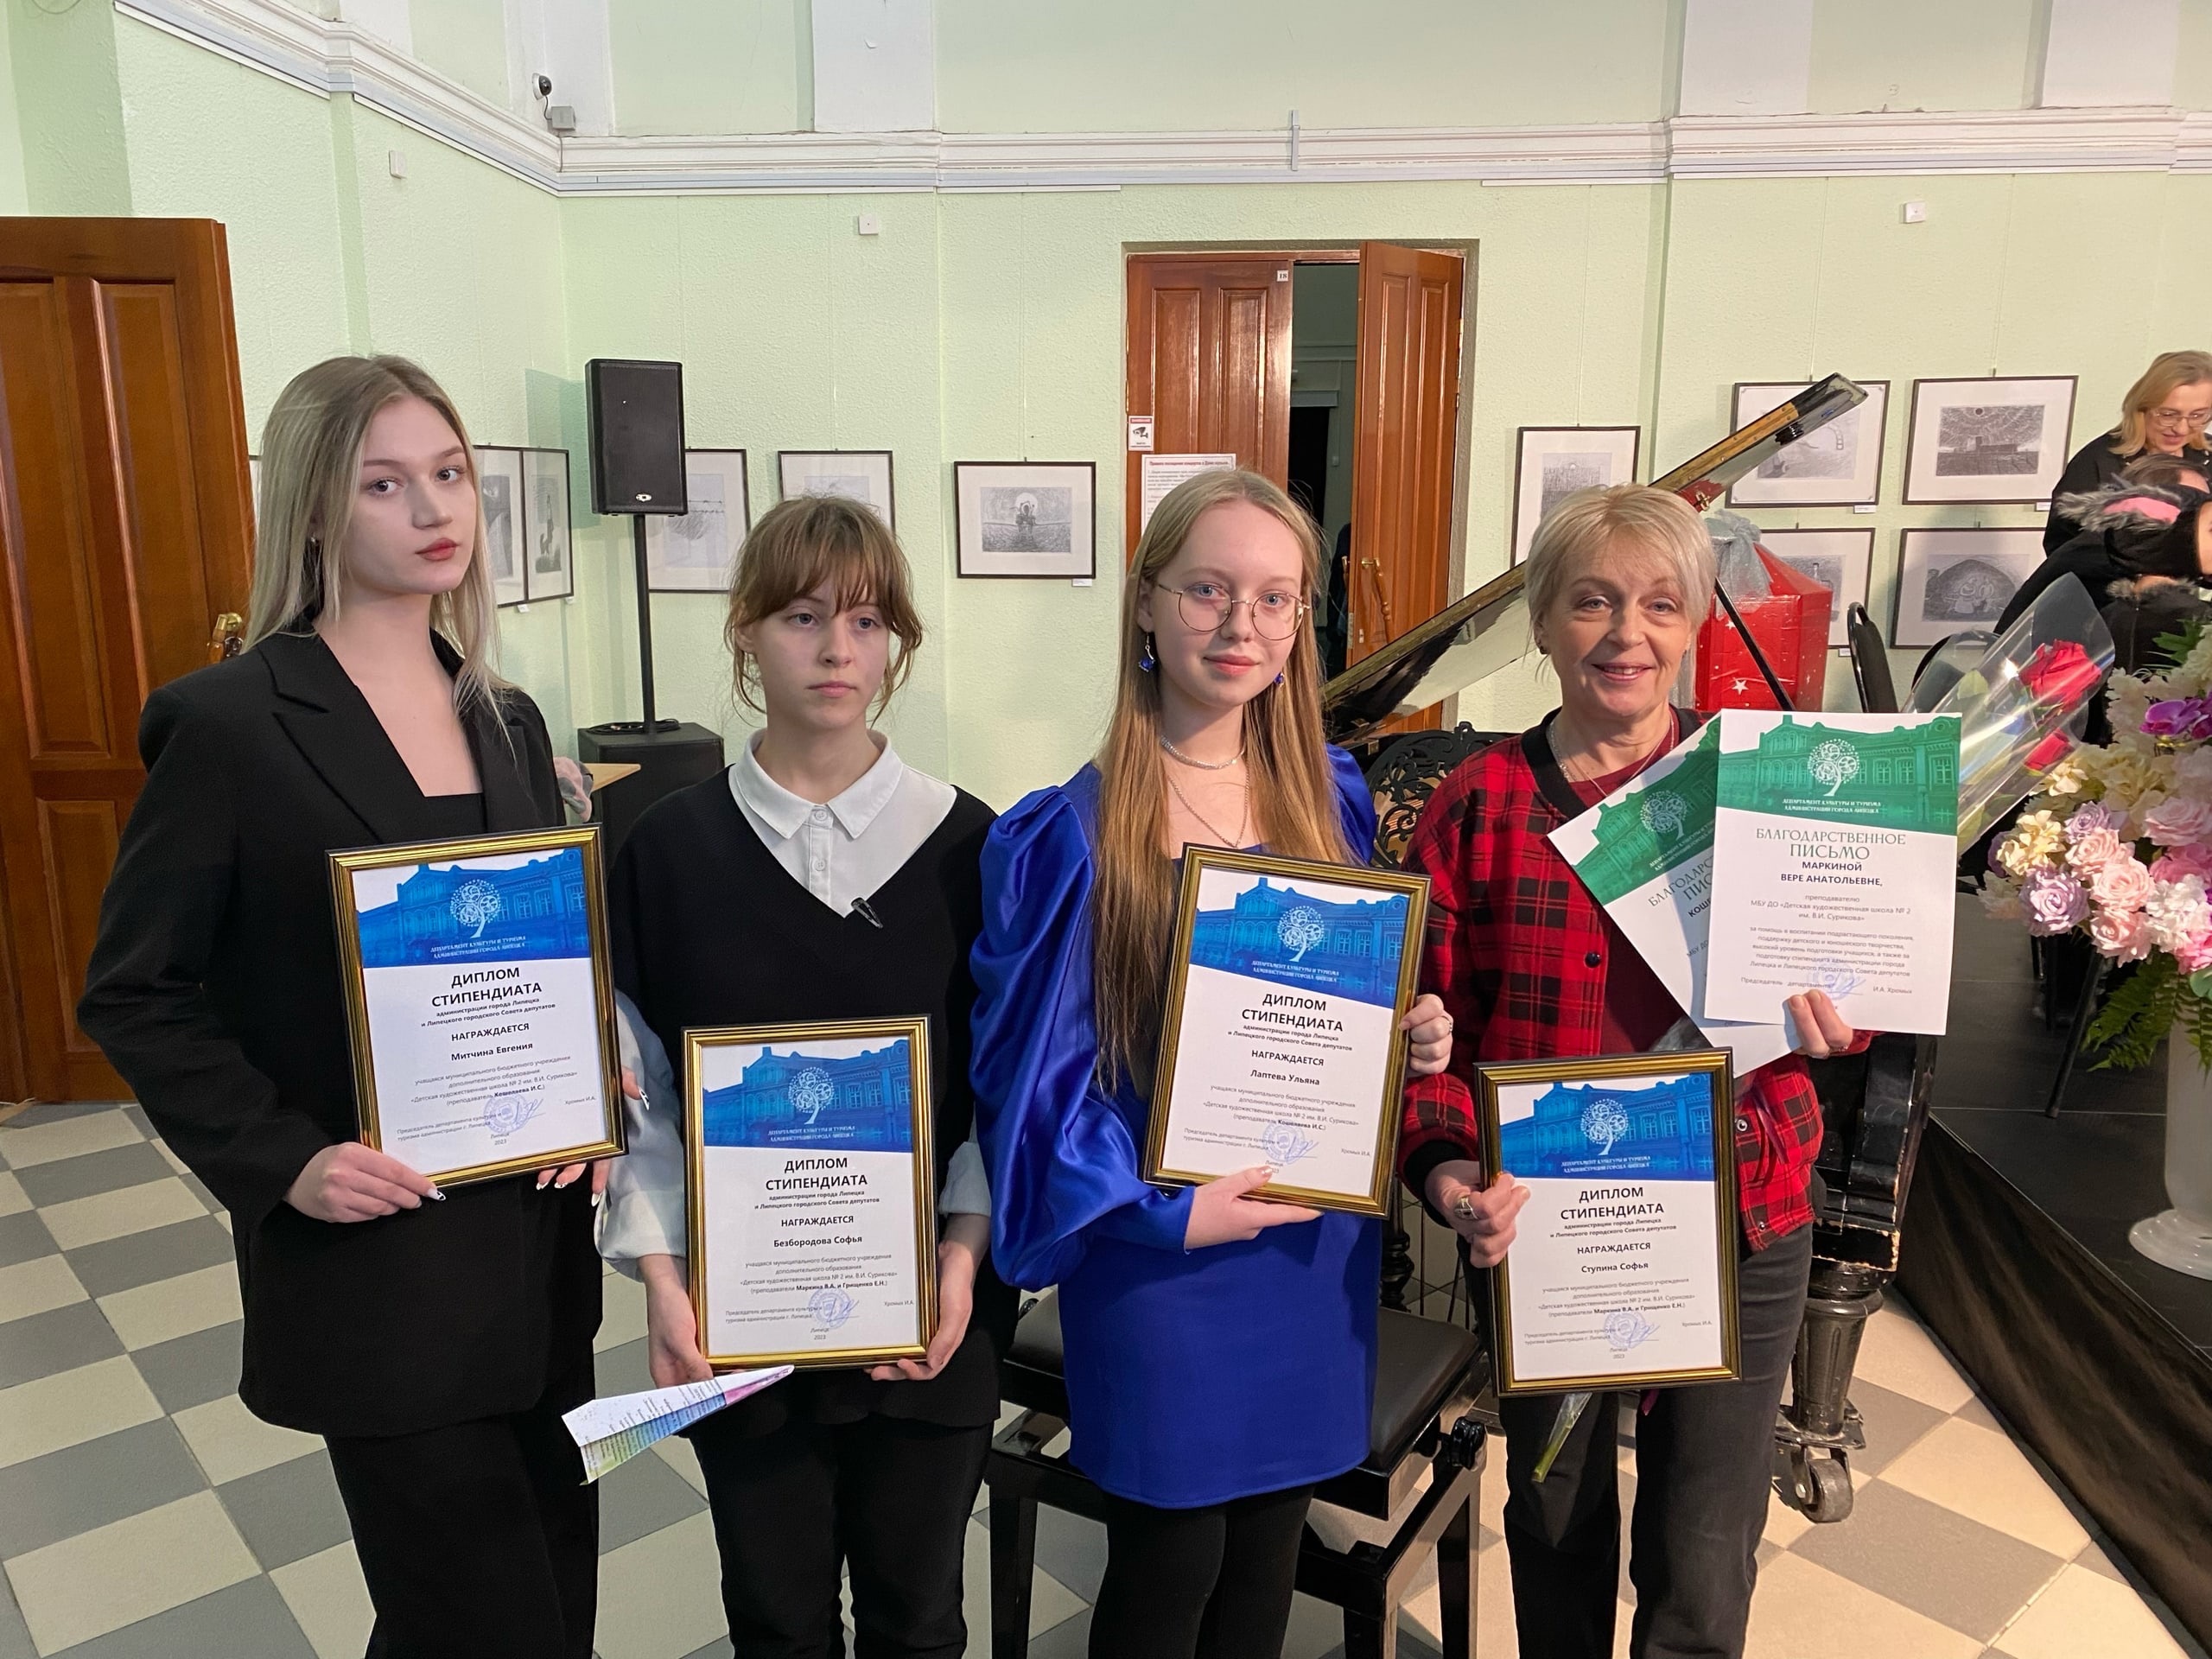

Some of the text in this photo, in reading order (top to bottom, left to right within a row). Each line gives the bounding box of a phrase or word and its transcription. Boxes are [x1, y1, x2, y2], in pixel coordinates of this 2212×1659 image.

[1756, 828, 1906, 845] БЛАГОДАРСТВЕННОЕ
[1790, 843, 1870, 860] ПИСЬМО
[1802, 861, 1862, 871] МАРКИНОЙ
[1781, 874, 1883, 887] ВЕРЕ АНАТОЛЬЕВНЕ,
[451, 967, 519, 989] ДИПЛОМ
[431, 982, 542, 1007] СТИПЕНДИАТА
[1262, 993, 1326, 1011] ДИПЛОМ
[427, 1017, 462, 1027] Липецкого
[463, 1012, 500, 1021] городского
[524, 1003, 556, 1013] депутатов
[436, 1005, 487, 1017] администрации
[488, 1001, 511, 1010] города
[1242, 1008, 1343, 1032] СТИПЕНДИАТА
[451, 1022, 530, 1041] НАГРАЖДАЕТСЯ
[1232, 1030, 1266, 1039] Липецкого
[1266, 1036, 1300, 1045] городского
[1300, 1039, 1321, 1047] Совета
[1243, 1025, 1290, 1034] администрации
[1313, 1033, 1339, 1041] Липецка
[451, 1043, 533, 1061] Митчина Евгения
[1251, 1050, 1324, 1066] НАГРАЖДАЕТСЯ
[1249, 1069, 1319, 1085] Лаптева Ульяна
[784, 1157, 848, 1173] ДИПЛОМ
[766, 1174, 868, 1191] СТИПЕНДИАТА
[1579, 1186, 1643, 1204] ДИПЛОМ
[1560, 1203, 1664, 1220] СТИПЕНДИАТА
[781, 1215, 854, 1227] НАГРАЖДАЕТСЯ
[773, 1235, 862, 1248] Безбородова Софья
[1577, 1242, 1650, 1255] НАГРАЖДАЕТСЯ
[1581, 1262, 1649, 1274] Ступина Софья
